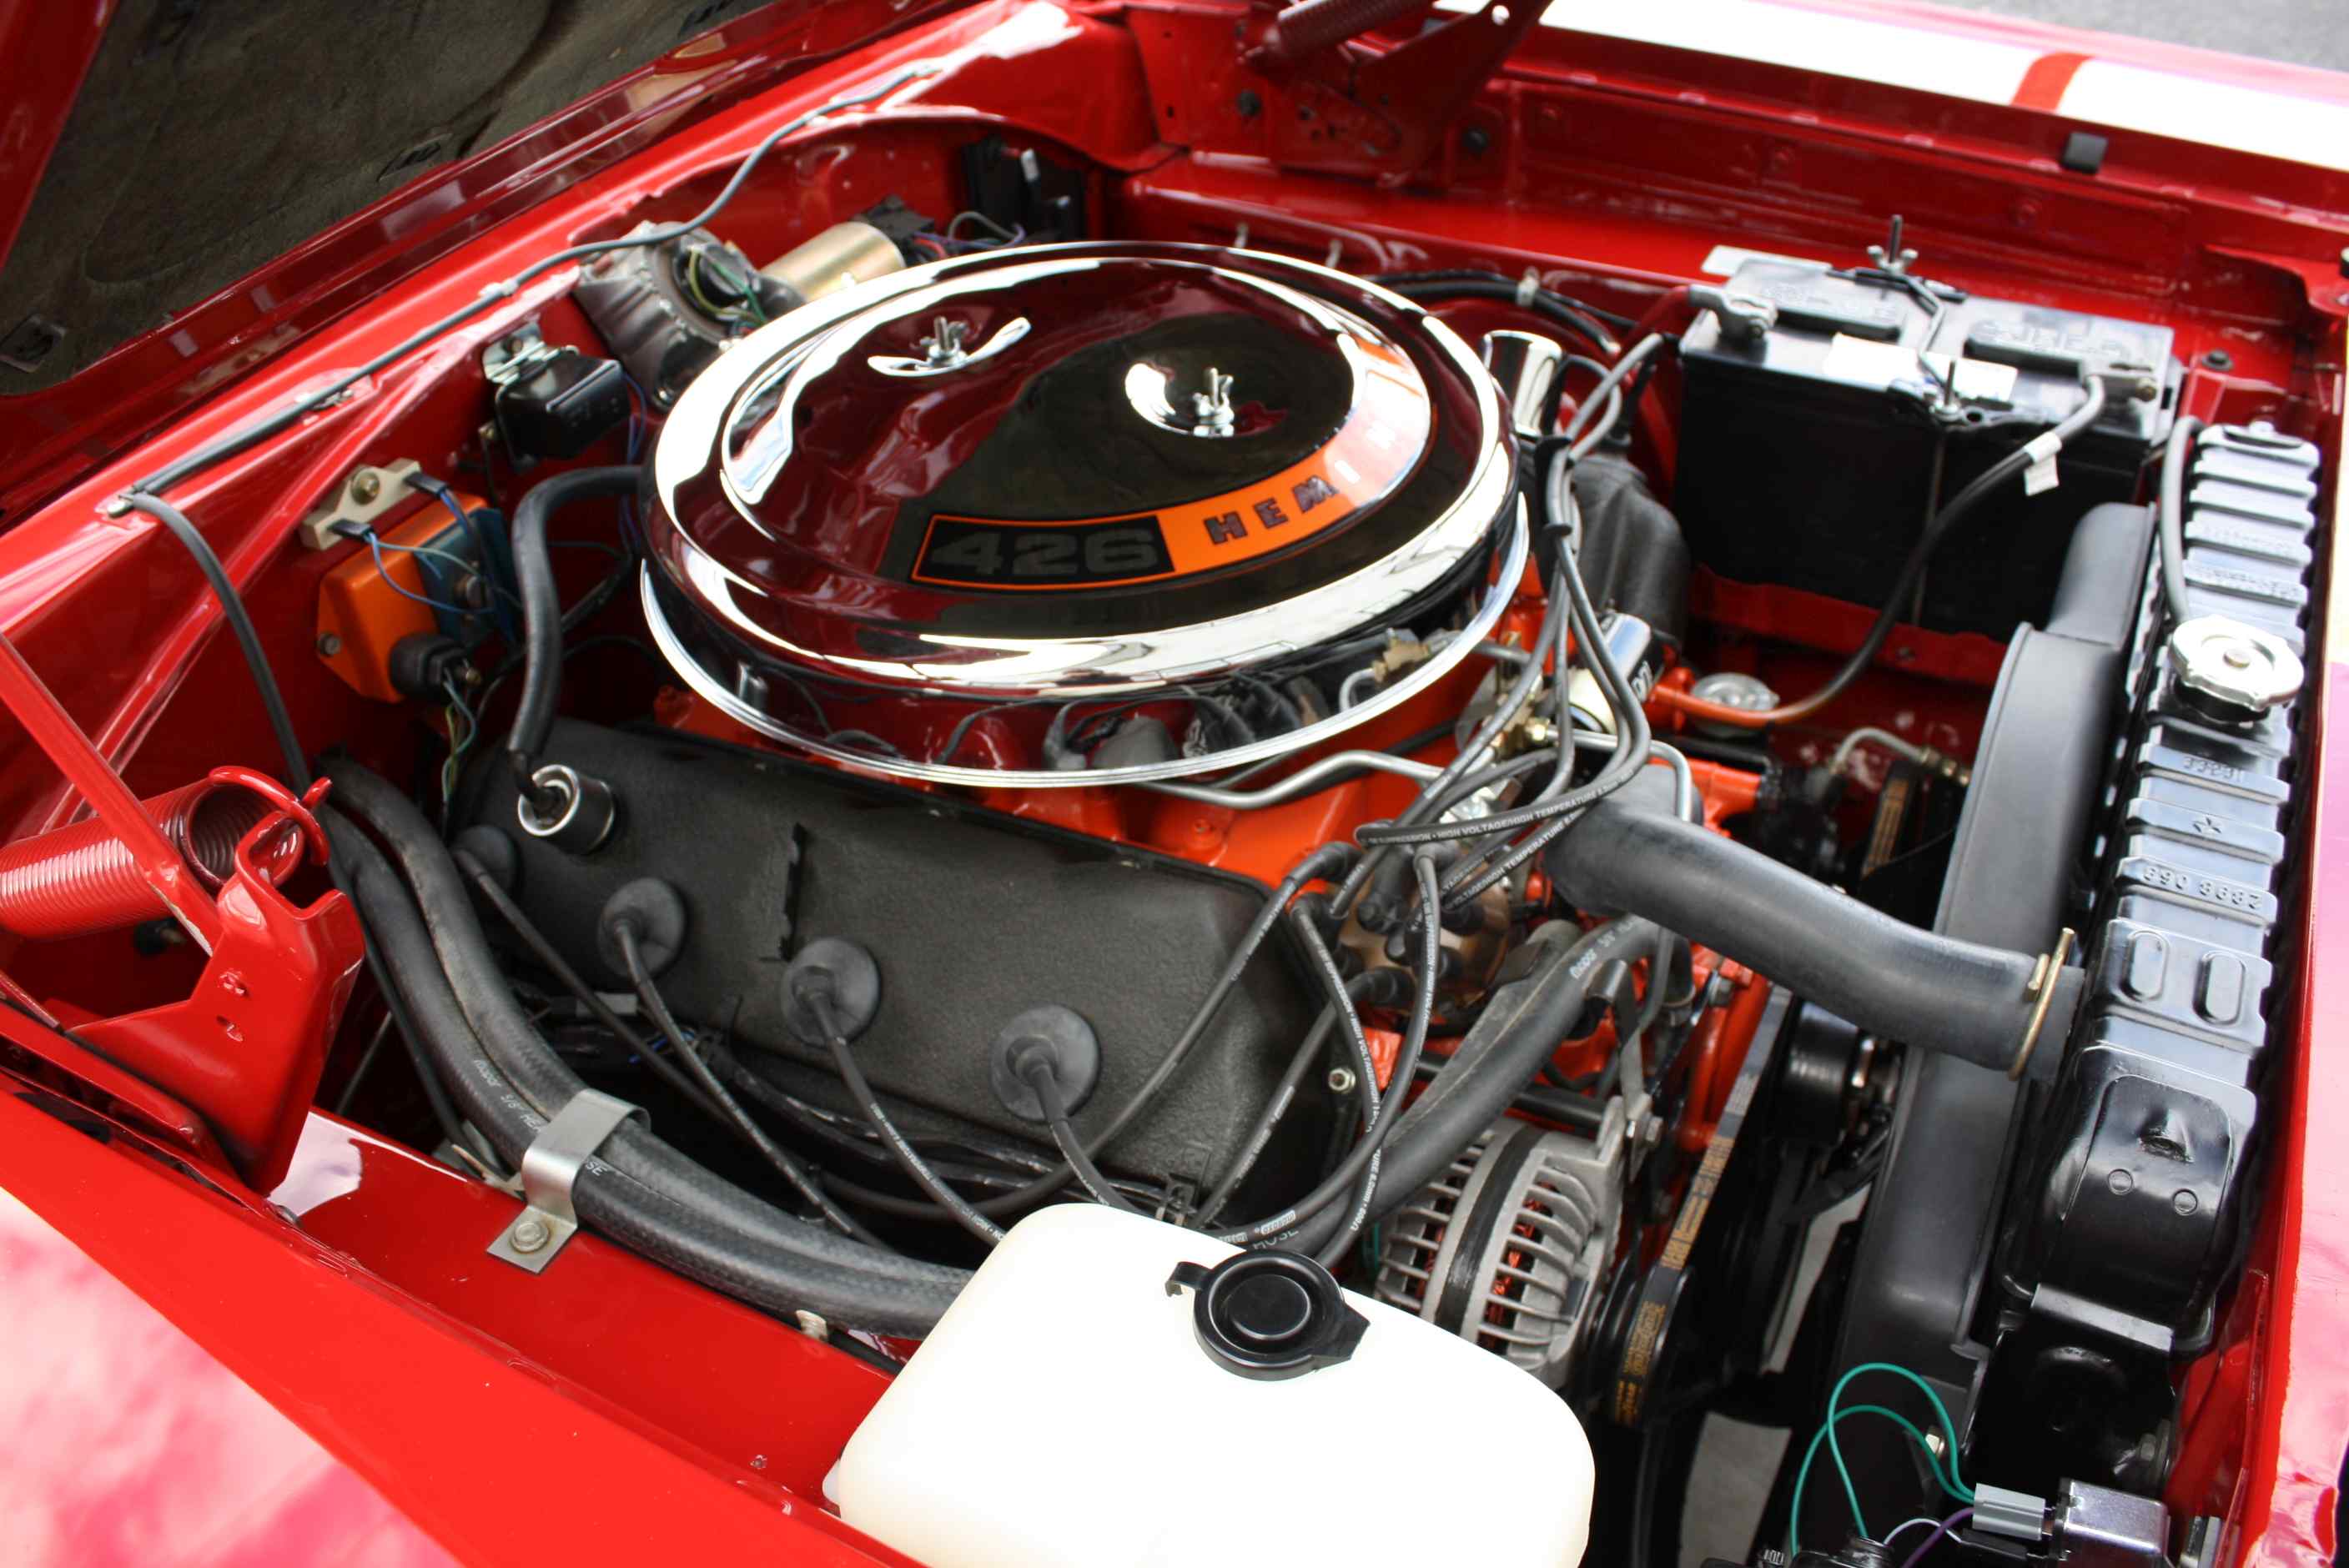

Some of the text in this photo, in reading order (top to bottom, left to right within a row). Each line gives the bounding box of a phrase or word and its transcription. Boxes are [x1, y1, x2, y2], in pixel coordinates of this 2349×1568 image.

[930, 460, 1361, 575] 426 HEMI
[1533, 791, 1597, 819] TEMPERATURE
[1504, 819, 1565, 870] TEMPERATURE
